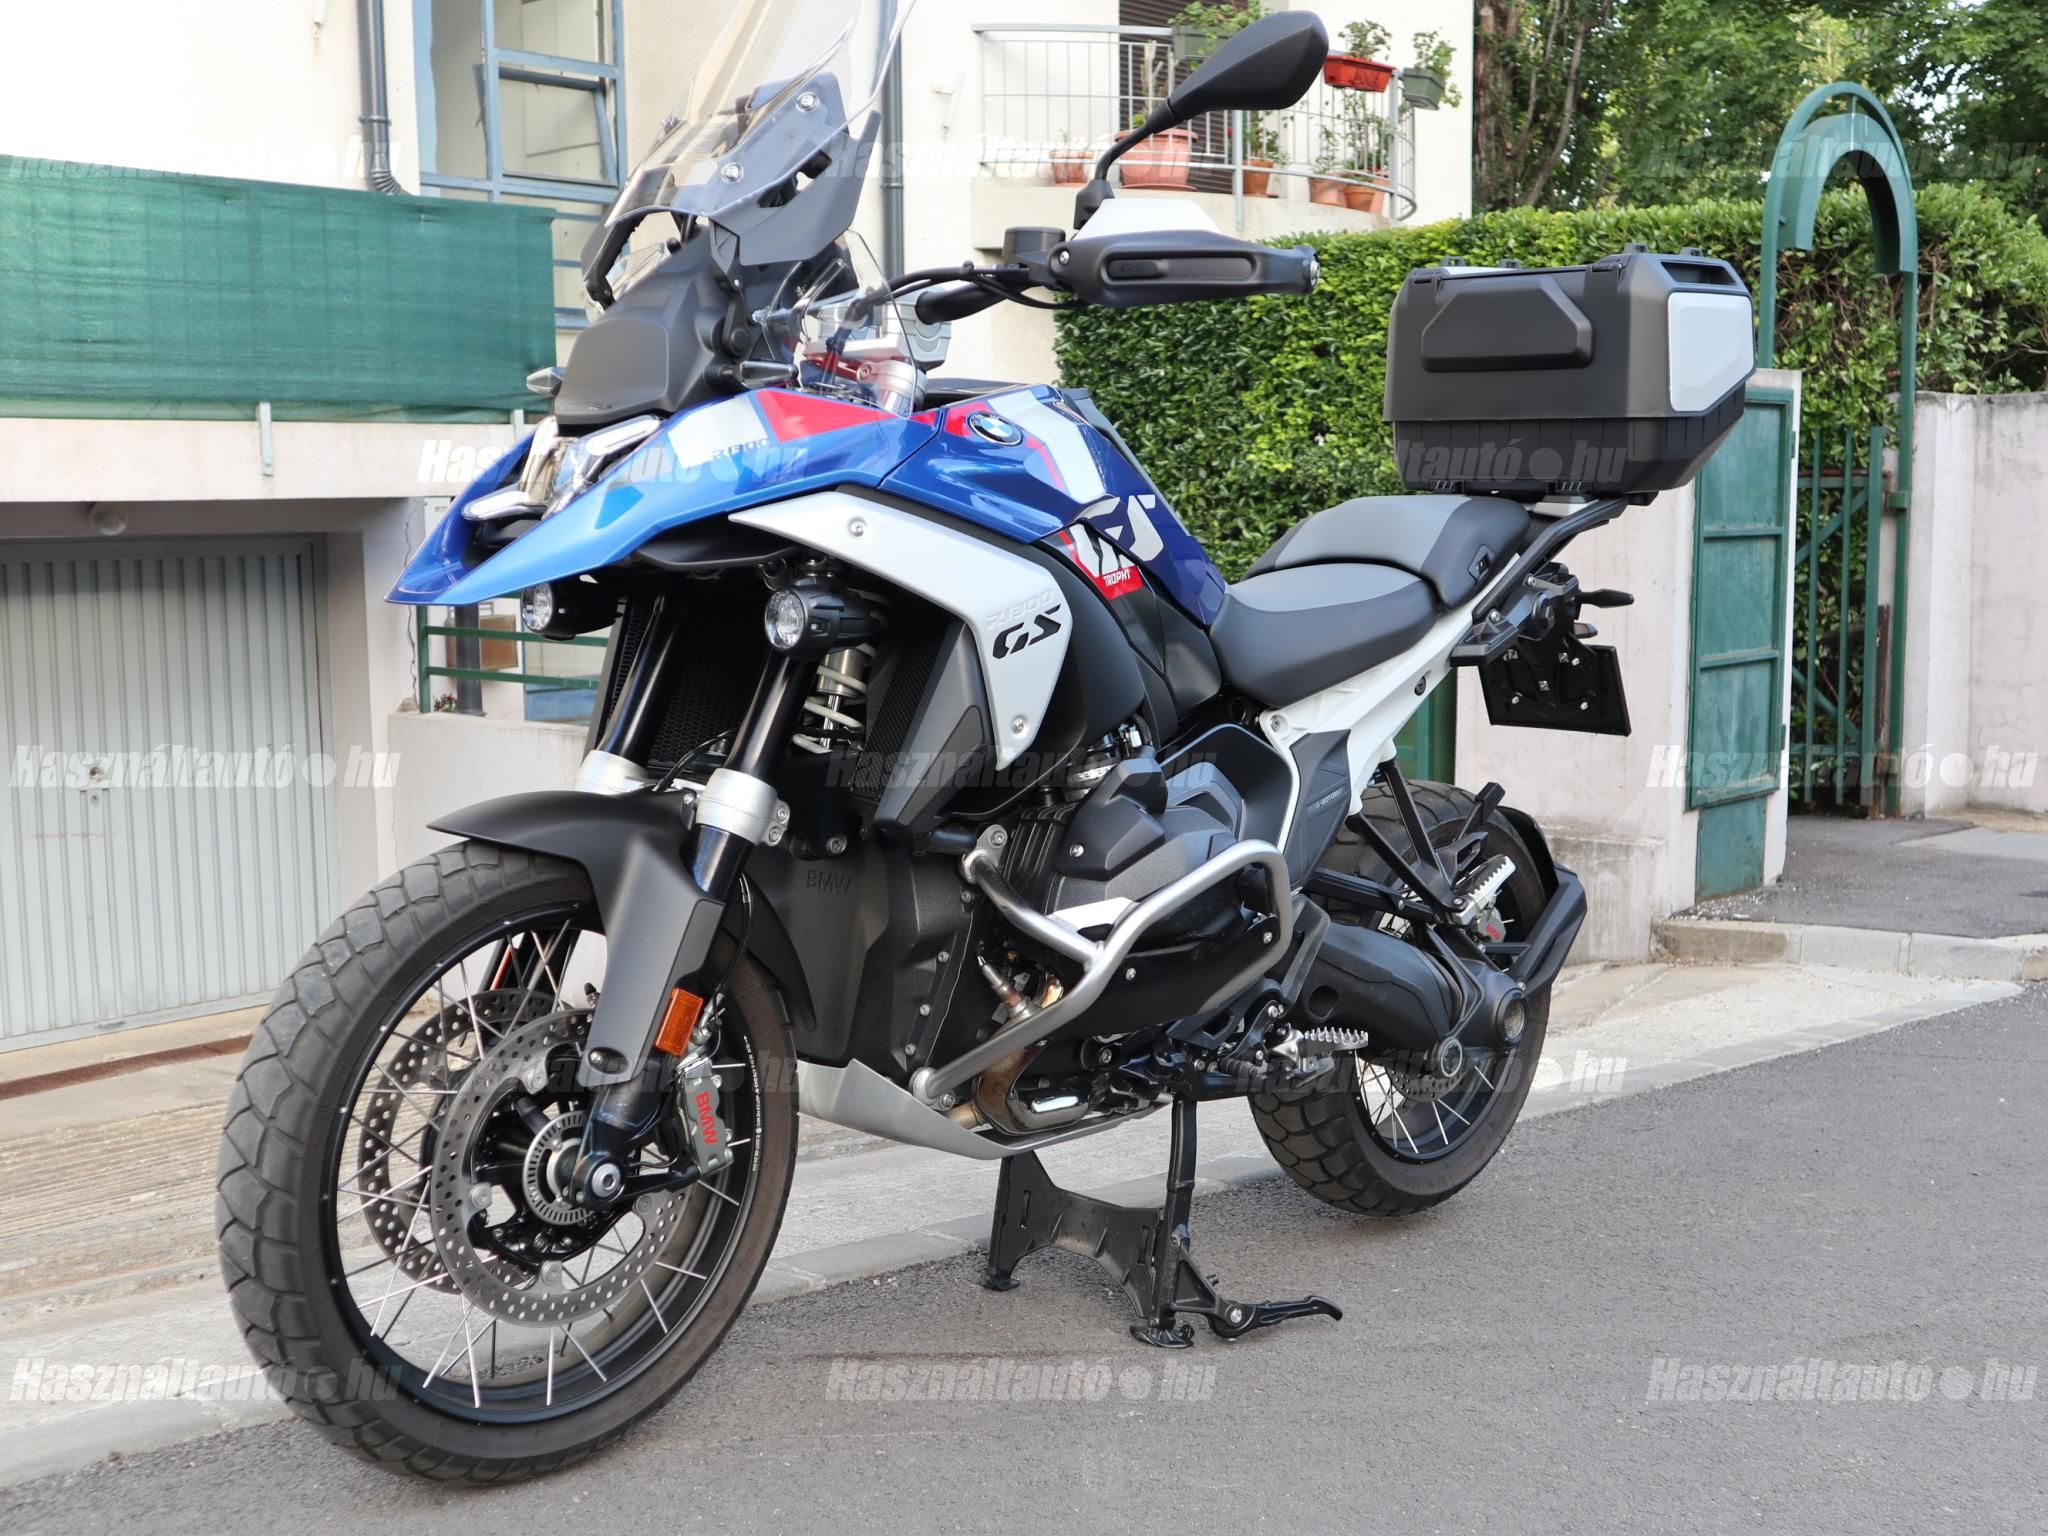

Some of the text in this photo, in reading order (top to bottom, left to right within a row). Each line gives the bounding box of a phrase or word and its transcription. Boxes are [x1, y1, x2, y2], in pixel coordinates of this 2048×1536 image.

[992, 603, 1062, 660] GS
[806, 869, 853, 897] BMW
[694, 1090, 718, 1144] BMW
